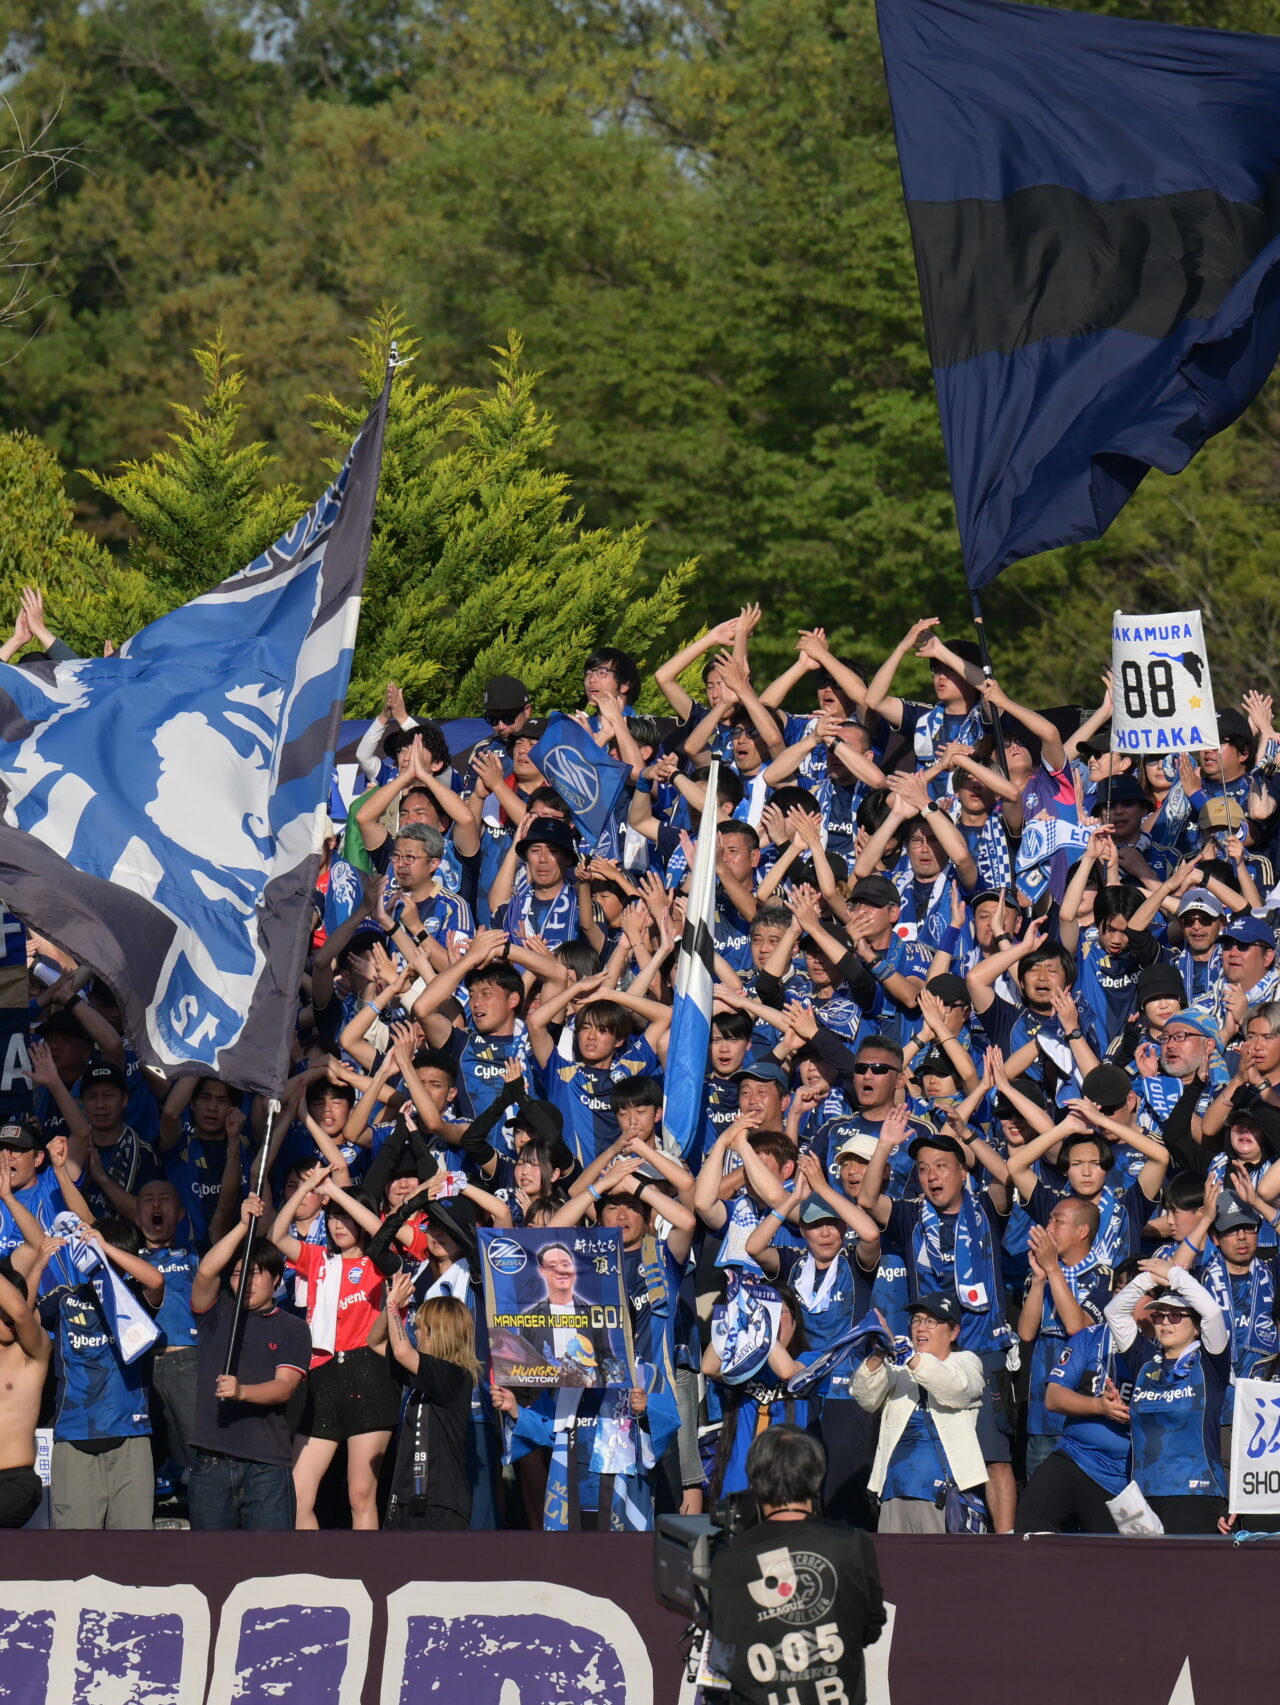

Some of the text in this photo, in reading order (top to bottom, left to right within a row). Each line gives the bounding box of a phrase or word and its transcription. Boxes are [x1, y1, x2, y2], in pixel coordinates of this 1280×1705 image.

[1120, 659, 1176, 719] 88
[493, 1304, 625, 1329] MANAGER KURODA GO!
[510, 1363, 561, 1377] HUNGRY
[517, 1375, 561, 1384] VICTORY
[747, 1622, 845, 1683] 005
